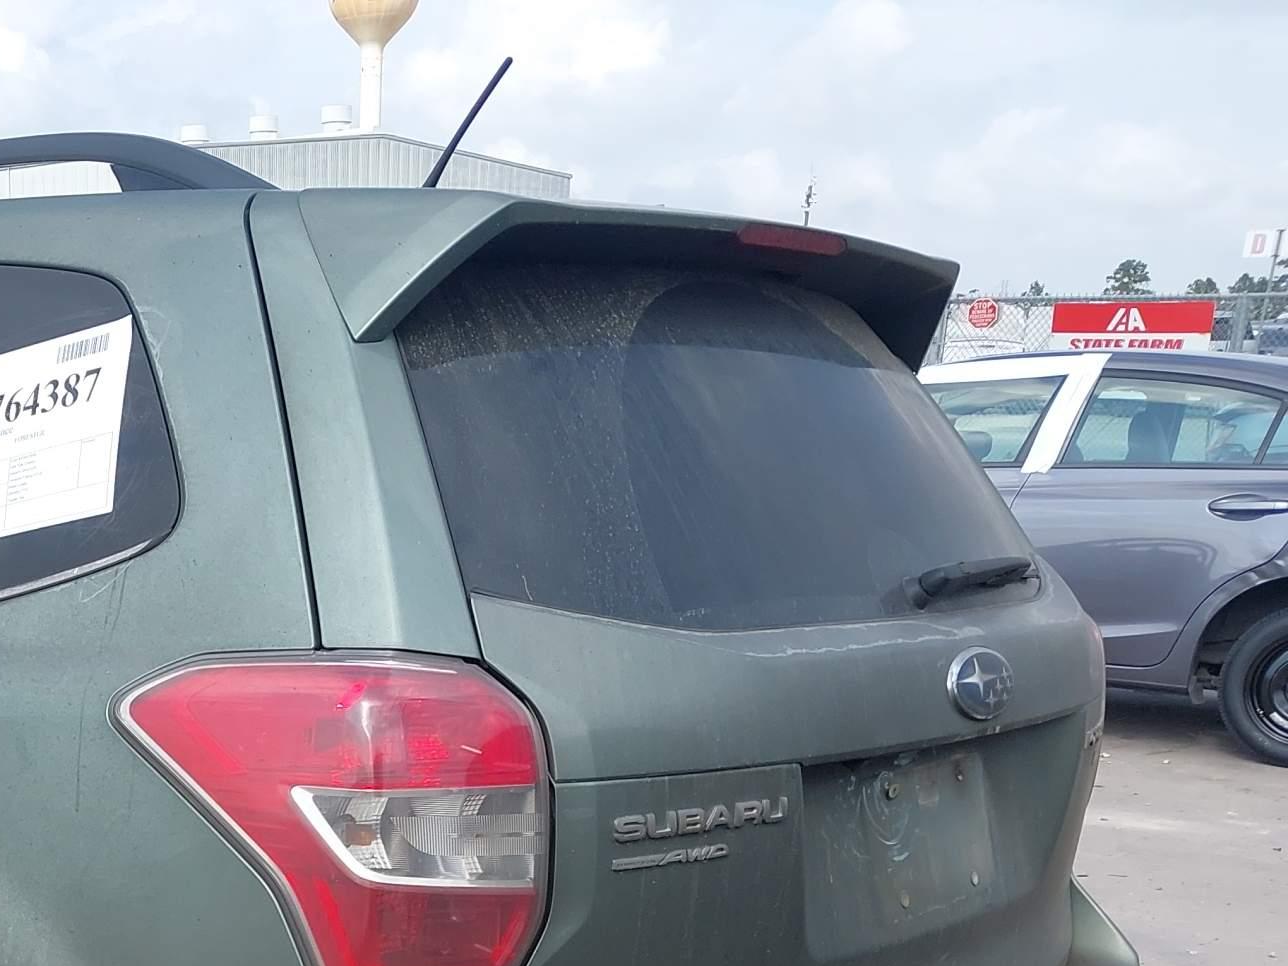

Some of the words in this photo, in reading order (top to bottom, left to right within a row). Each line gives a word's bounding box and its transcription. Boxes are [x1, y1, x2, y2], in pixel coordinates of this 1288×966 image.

[1250, 233, 1267, 254] D
[973, 301, 993, 310] STOP
[1068, 338, 1125, 350] STATE
[1127, 338, 1185, 350] FARM
[613, 795, 789, 843] SUBARU
[657, 843, 729, 867] AWD
